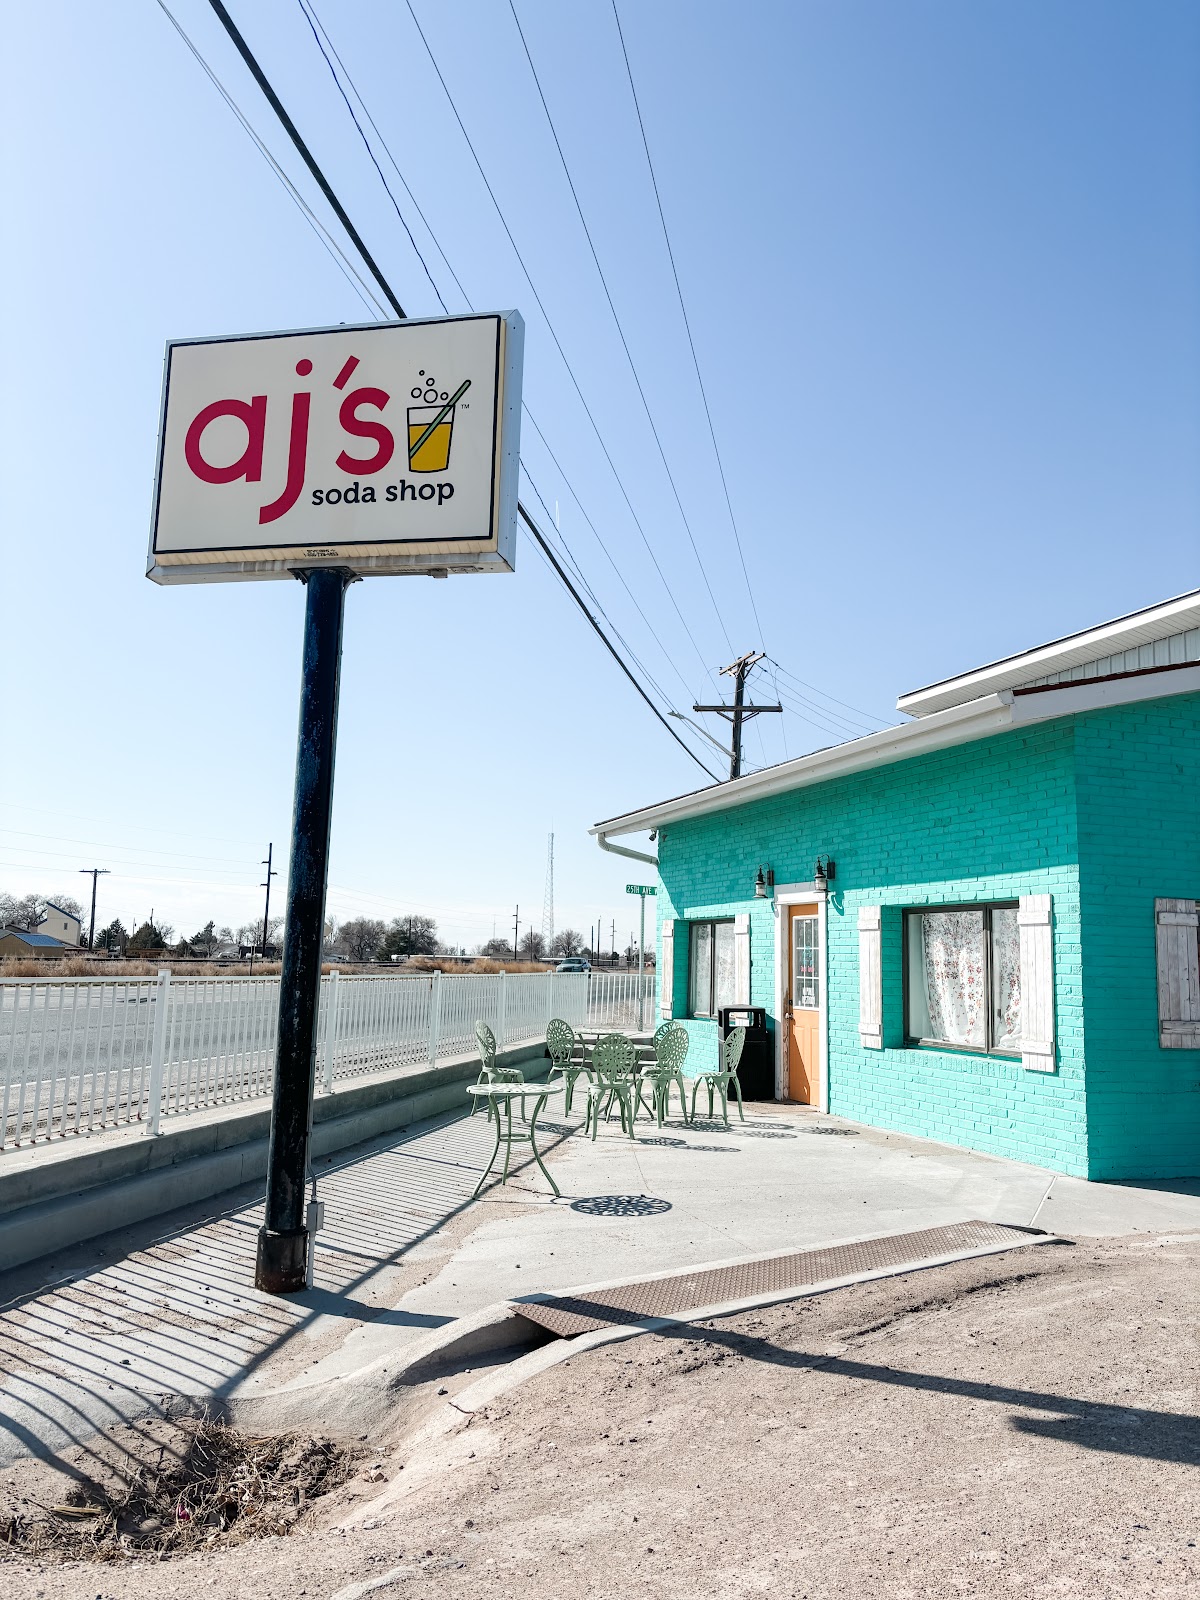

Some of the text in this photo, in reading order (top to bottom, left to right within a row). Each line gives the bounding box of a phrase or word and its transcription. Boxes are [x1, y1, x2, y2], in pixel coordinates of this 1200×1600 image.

[184, 355, 395, 525] aj's
[311, 479, 455, 506] soda shop
[626, 885, 640, 894] 25TH
[642, 886, 652, 895] AVE
